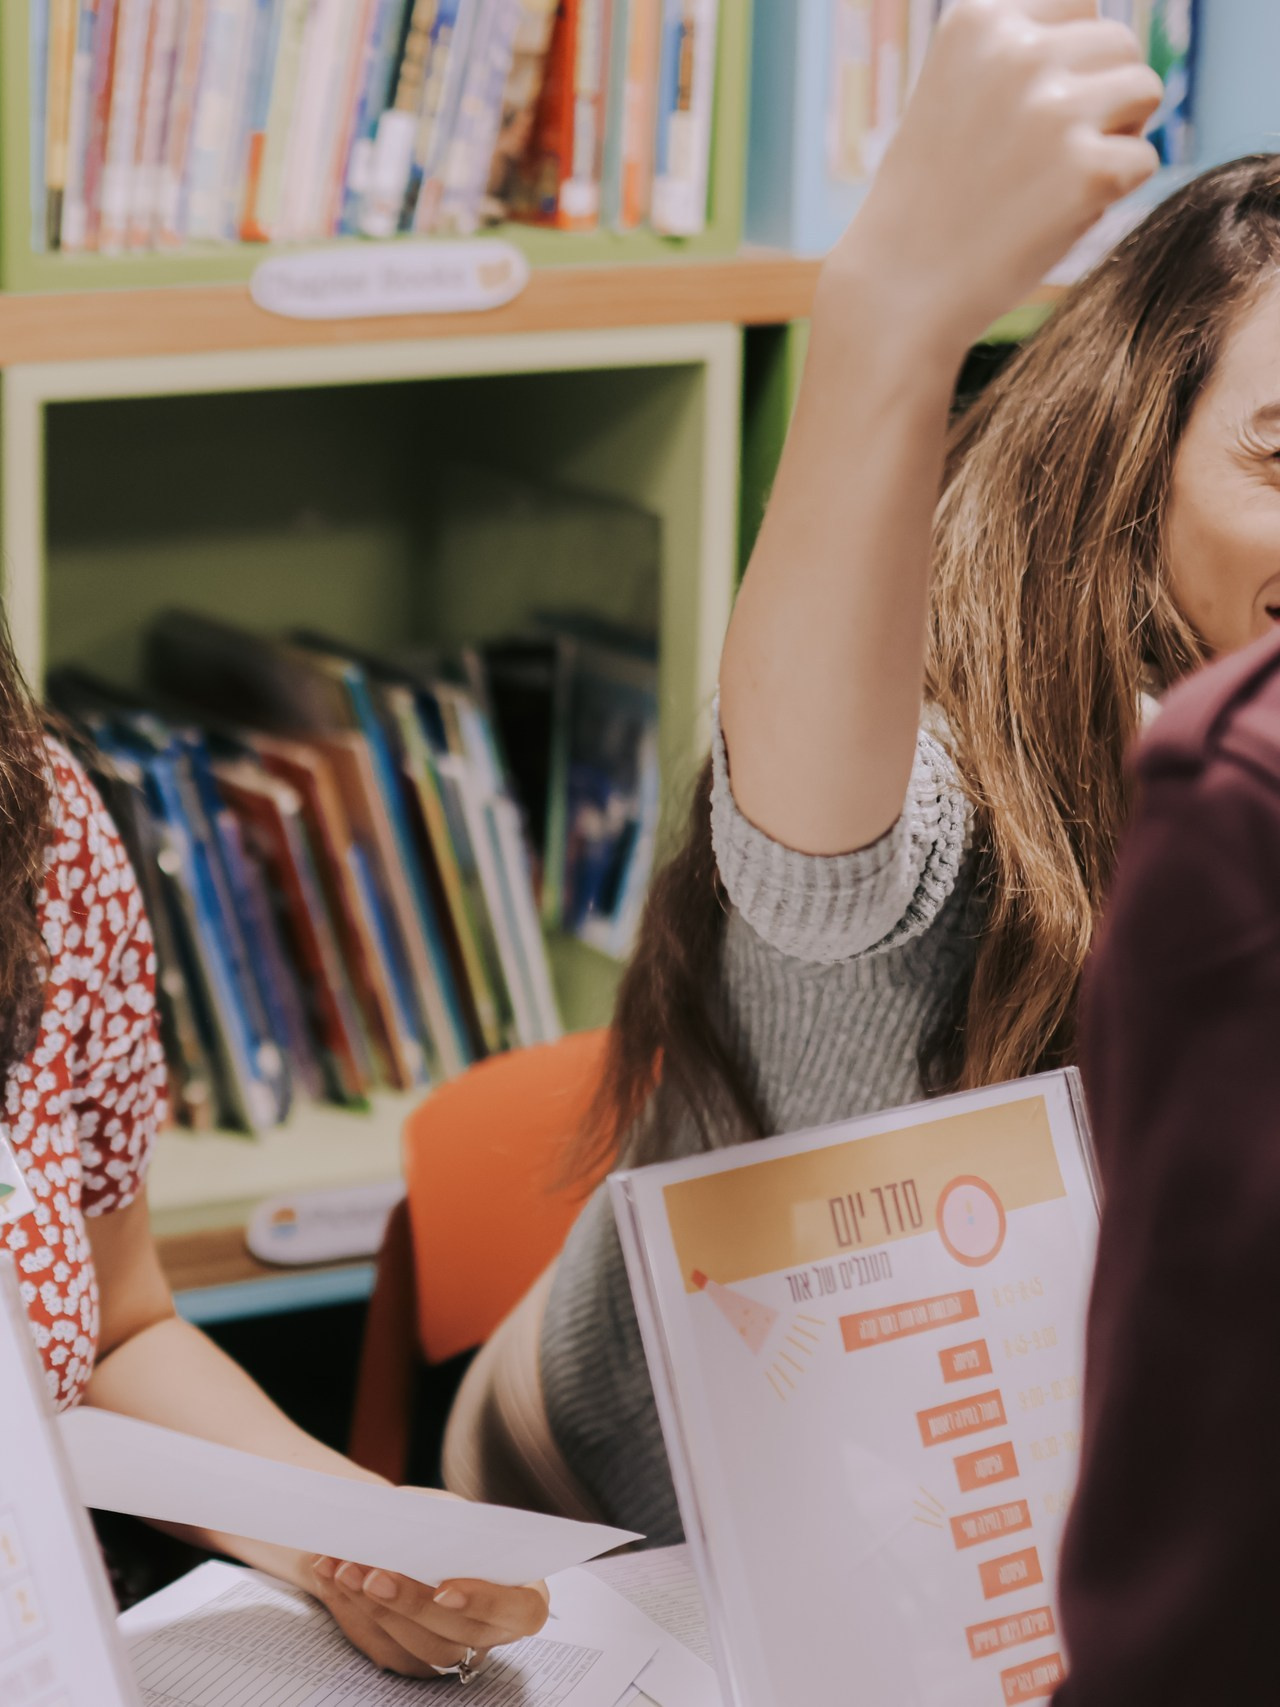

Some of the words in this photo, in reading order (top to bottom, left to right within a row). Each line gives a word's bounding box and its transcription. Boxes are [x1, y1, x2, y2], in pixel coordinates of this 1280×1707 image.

[828, 1191, 866, 1248] יום
[869, 1178, 923, 1236] סדר
[785, 1270, 814, 1304] אור
[811, 1265, 838, 1297] של
